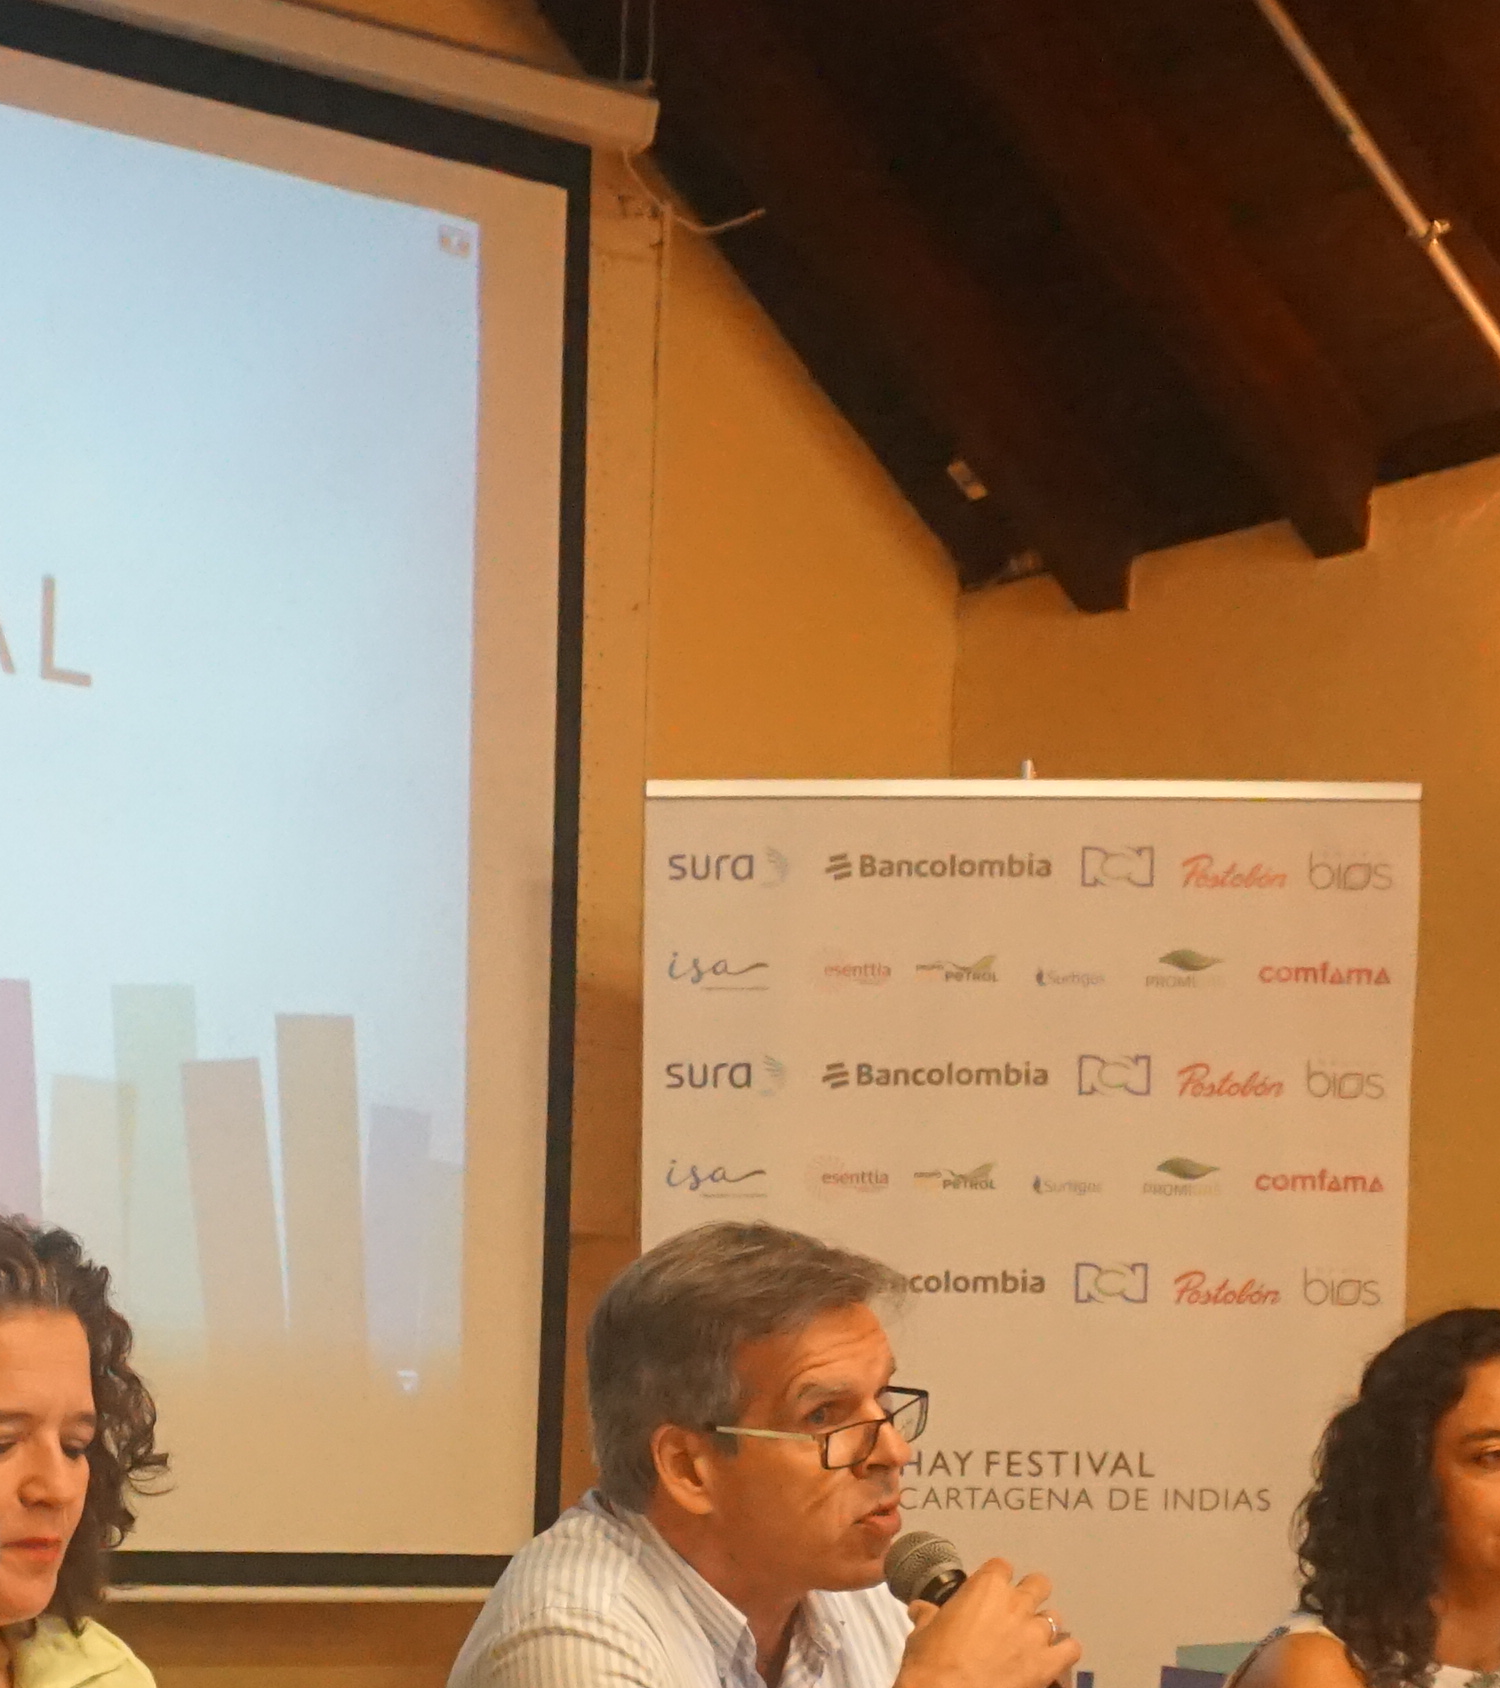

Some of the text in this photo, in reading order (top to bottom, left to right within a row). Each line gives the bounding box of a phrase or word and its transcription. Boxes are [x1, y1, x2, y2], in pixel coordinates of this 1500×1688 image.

[668, 852, 755, 882] sura
[859, 852, 1053, 879] Bancolombia
[1258, 961, 1392, 986] comfama
[665, 1061, 753, 1090] sura
[856, 1061, 1049, 1088] Bancolombia
[1255, 1168, 1385, 1193] comfama
[893, 1268, 1047, 1294] colombia
[900, 1450, 1155, 1478] HAY FESTIVAL
[899, 1485, 1272, 1513] CARTAGENA DE INDIAS
